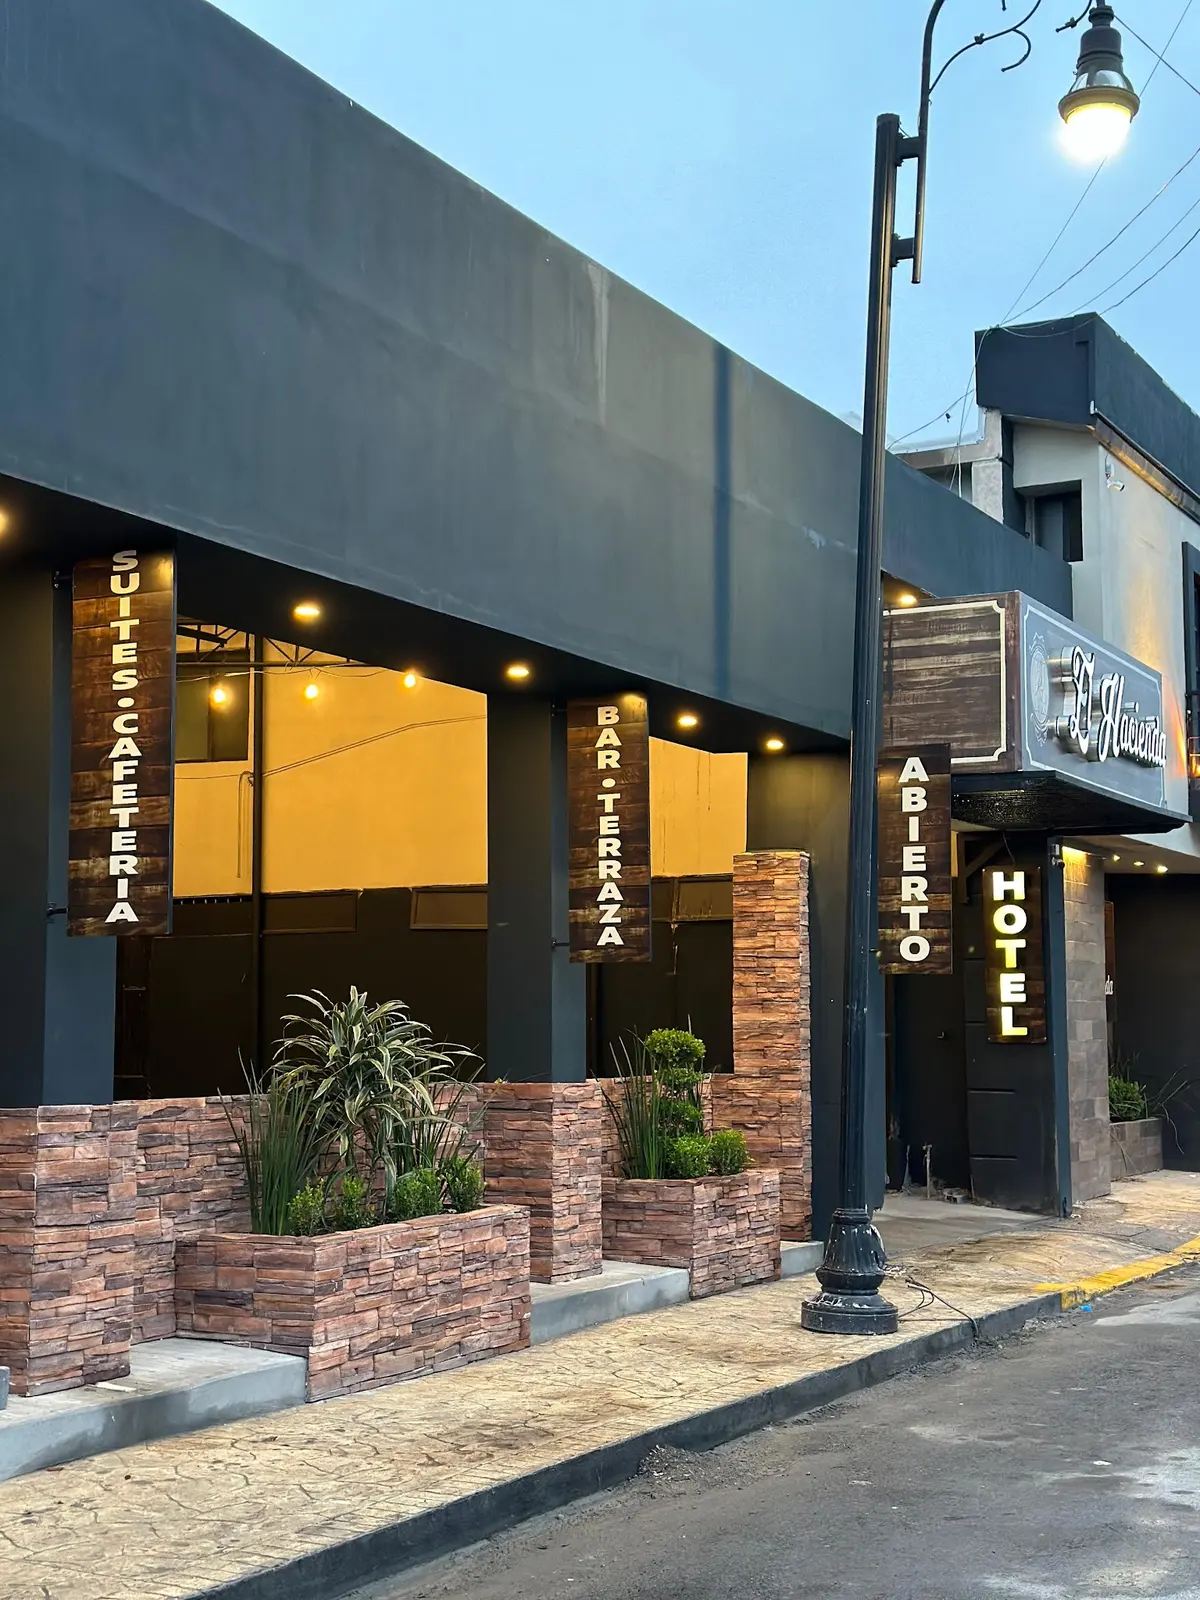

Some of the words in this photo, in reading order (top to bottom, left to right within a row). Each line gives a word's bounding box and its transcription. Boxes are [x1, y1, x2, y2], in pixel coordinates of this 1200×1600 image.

[109, 549, 140, 691] SUITES
[594, 706, 623, 770] BAR
[1099, 672, 1167, 768] Hacienda
[104, 713, 143, 924] CAFETERIA
[596, 793, 625, 946] TERRAZA
[898, 756, 931, 962] ABIERTO
[992, 871, 1029, 1036] HOTEL
